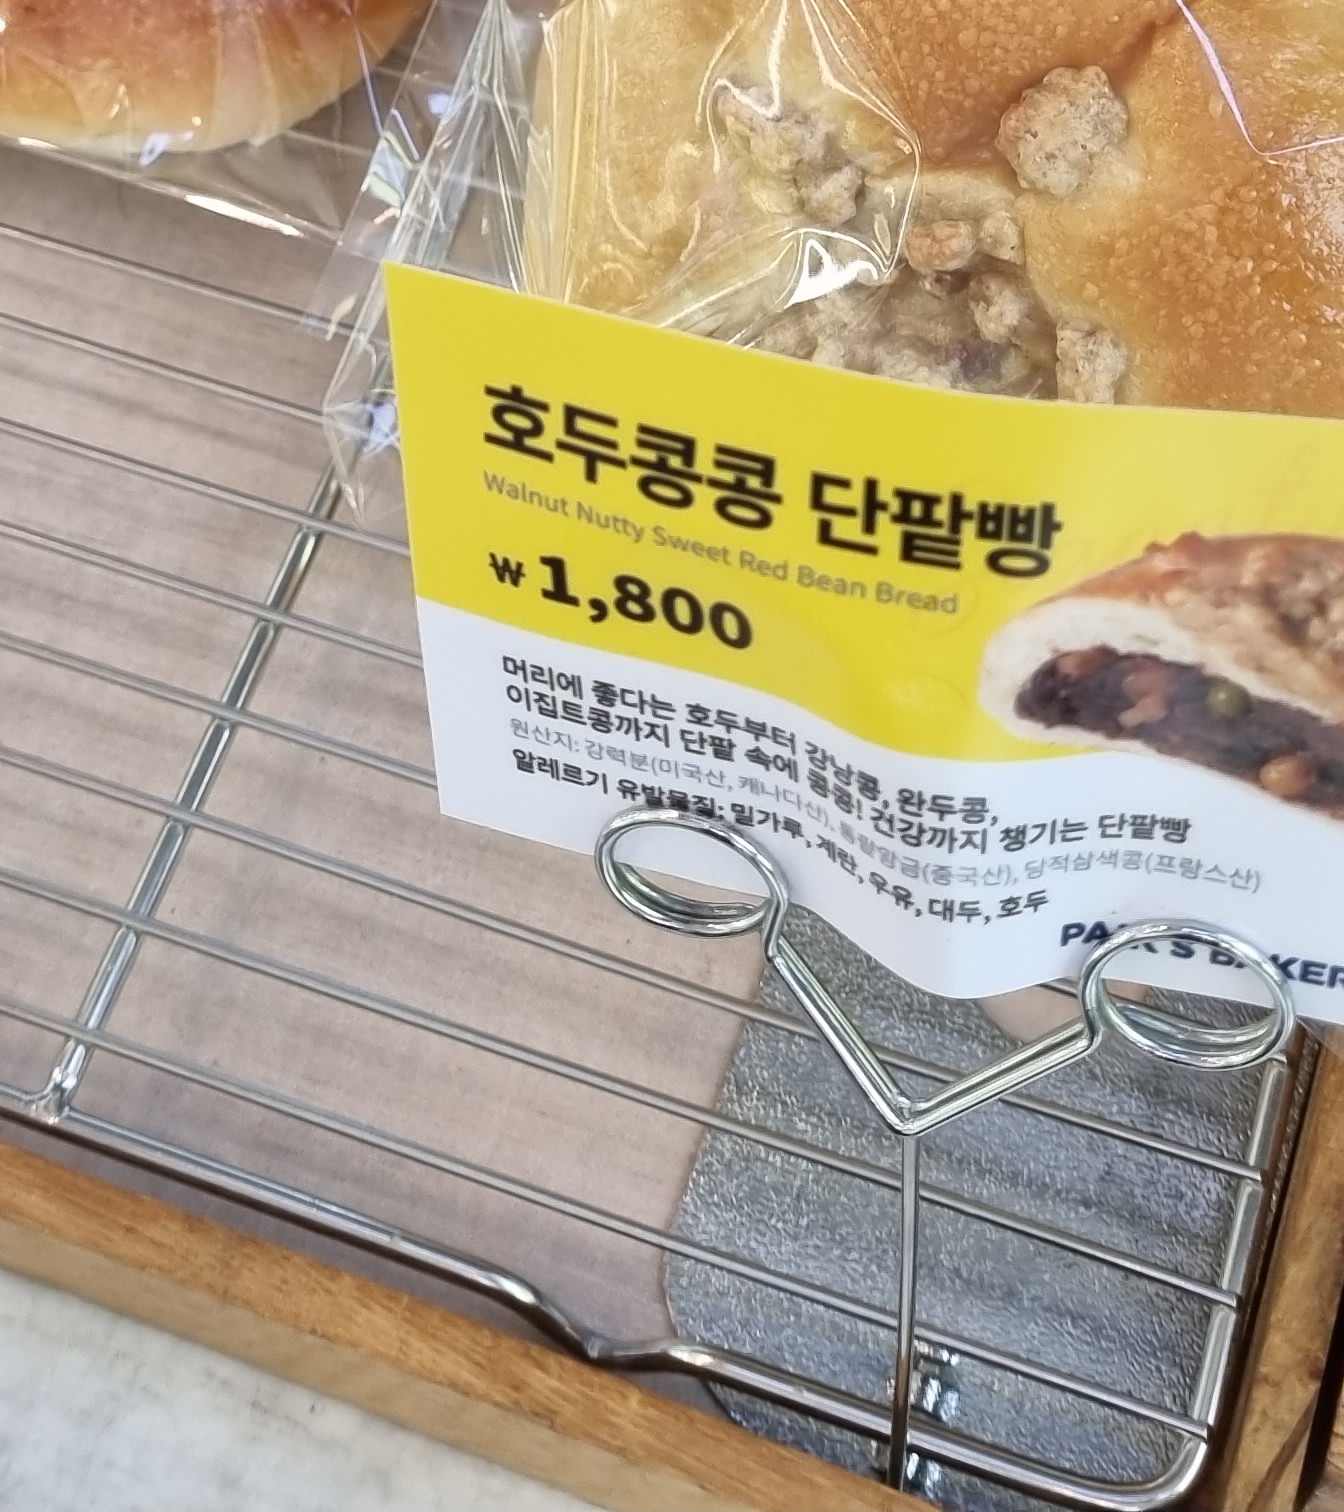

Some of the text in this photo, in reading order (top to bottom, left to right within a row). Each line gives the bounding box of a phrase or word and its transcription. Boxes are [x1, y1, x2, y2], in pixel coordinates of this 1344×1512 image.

[483, 384, 1063, 578] 호두콩콩 단팥빵
[483, 470, 959, 614] Walnut Nutty Sweet Red Bean Bread
[503, 655, 999, 826] 머리에 좋다는 호두부터 강낭콩, 완두콩,
[506, 685, 1191, 855] 이집트콩까지 단팥 속에 콩콩! 건강까지 챙기는 단팥빵
[510, 718, 579, 752] 원산지:
[512, 748, 608, 794] 알레르기
[730, 802, 812, 849] 밀가루,
[816, 834, 864, 884] 계란,
[869, 871, 922, 917] 우유,
[928, 898, 991, 925] 대두,
[997, 889, 1049, 918] 호두
